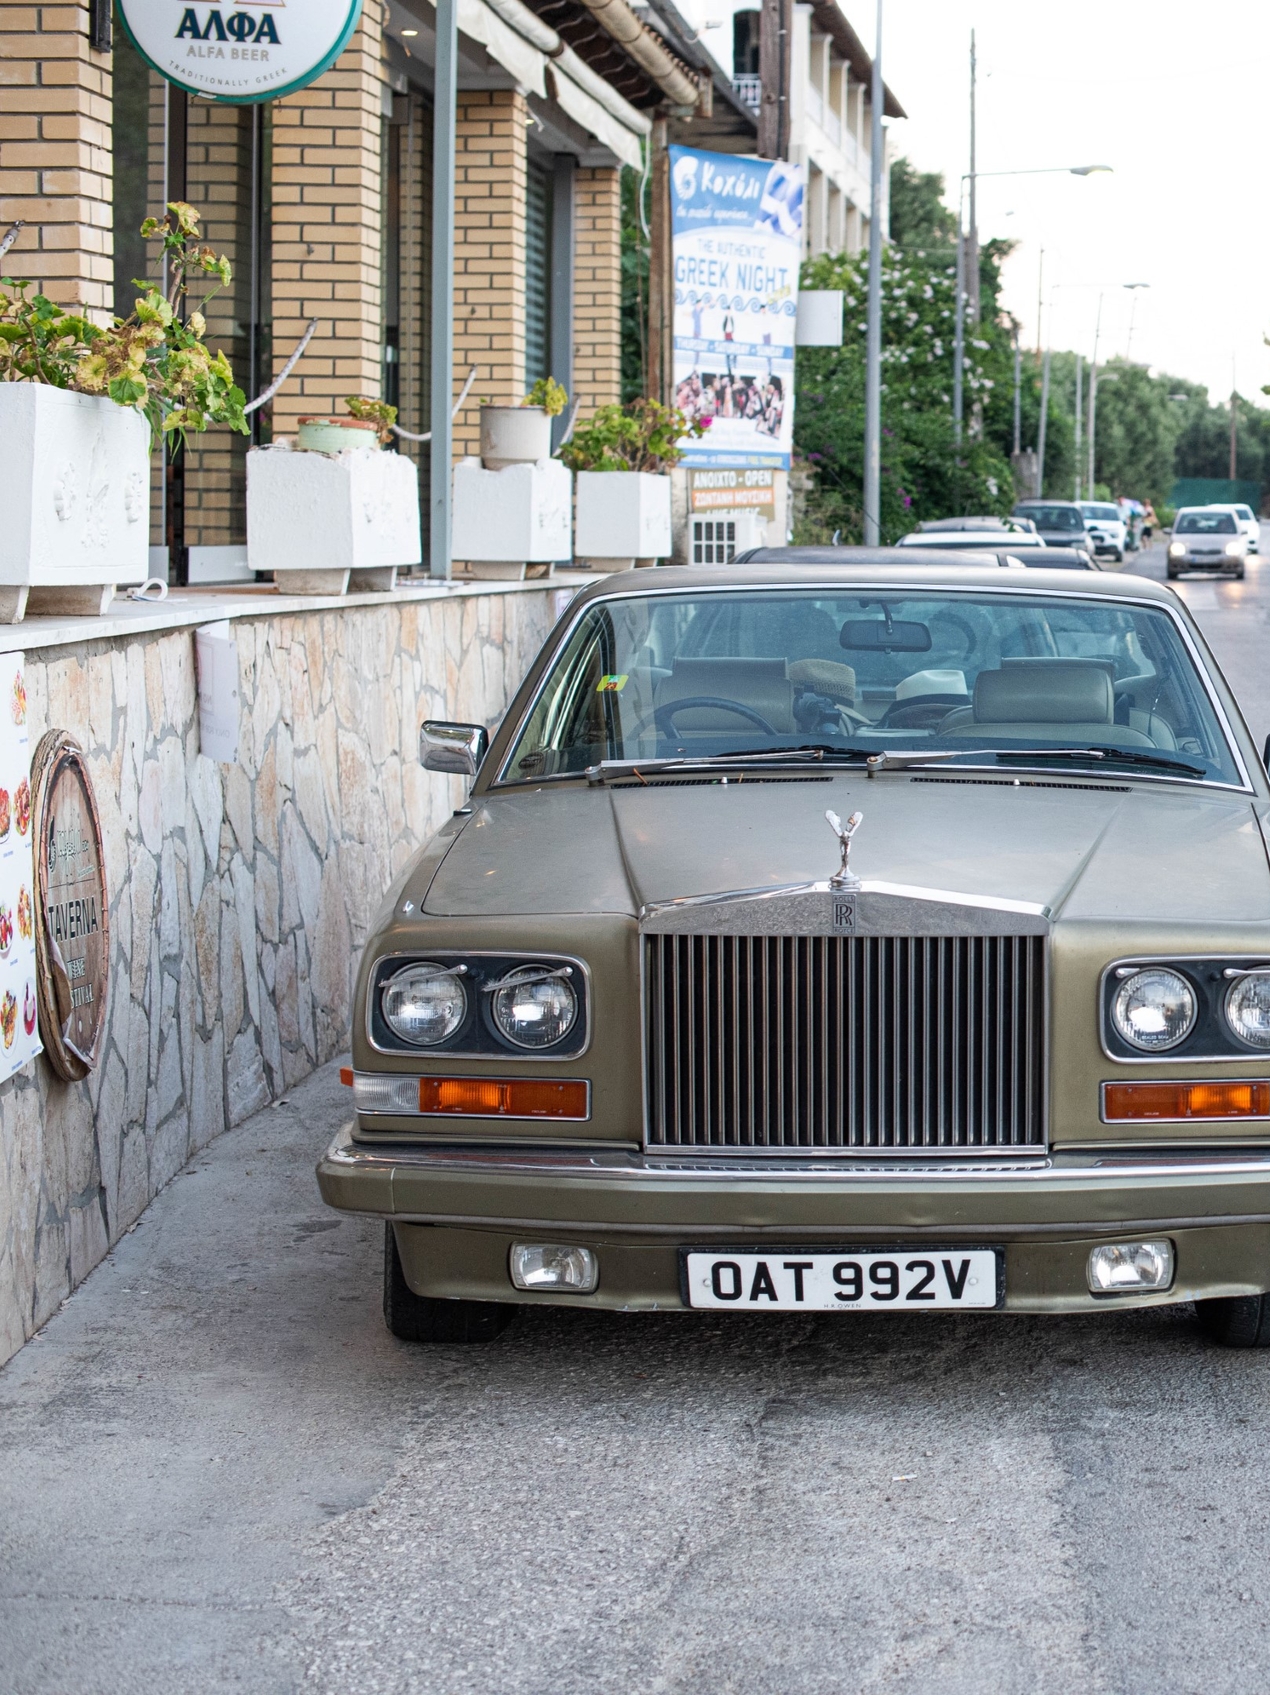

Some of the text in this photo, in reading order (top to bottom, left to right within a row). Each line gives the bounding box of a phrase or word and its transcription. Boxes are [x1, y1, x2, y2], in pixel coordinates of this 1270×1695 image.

[174, 8, 282, 45] ΑΛΦΑ
[186, 45, 270, 62] ALFA BEER
[169, 60, 288, 87] TRADITIONALLY GREEK
[697, 238, 767, 259] THE AUTHENTIC
[675, 255, 788, 292] GREEK NIGHT
[745, 470, 772, 487] OPEN
[48, 897, 98, 943] TAVERNA
[711, 1259, 971, 1302] OAT 992V
